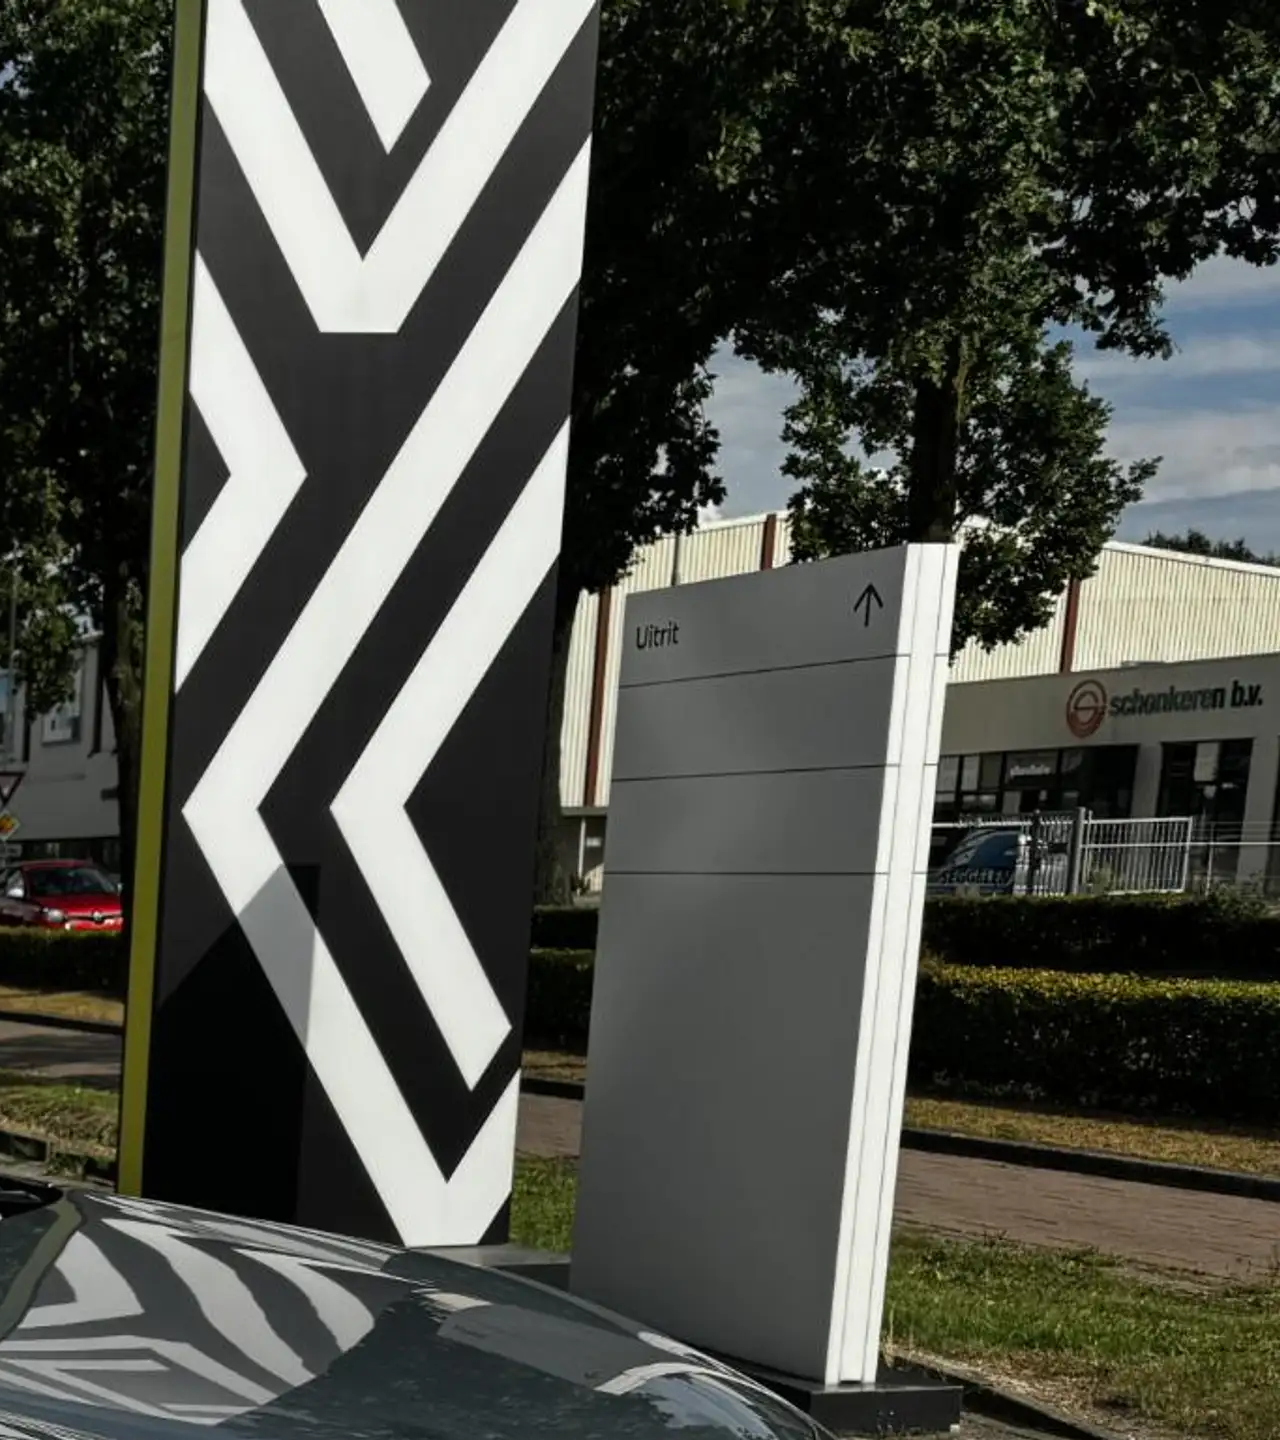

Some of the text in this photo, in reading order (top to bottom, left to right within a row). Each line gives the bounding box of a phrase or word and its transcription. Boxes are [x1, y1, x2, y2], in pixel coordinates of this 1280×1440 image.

[636, 620, 680, 650] Uitrit
[1109, 680, 1264, 716] schonkeren b.v.
